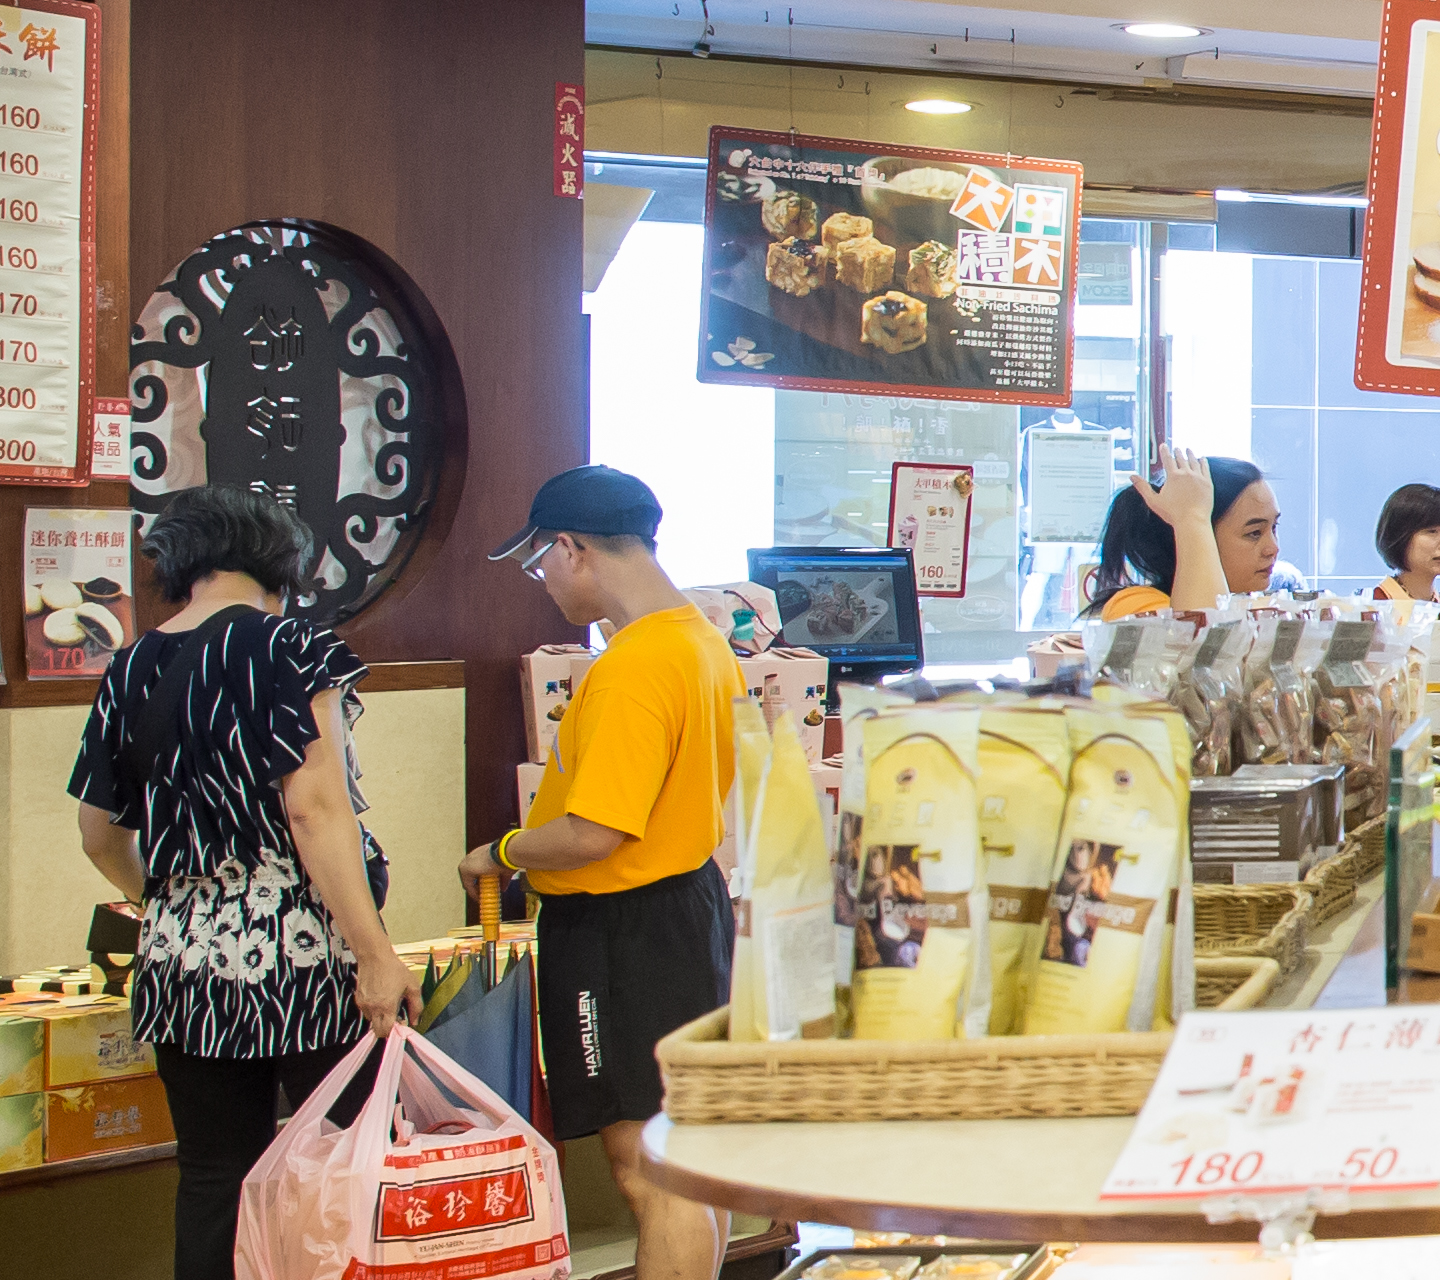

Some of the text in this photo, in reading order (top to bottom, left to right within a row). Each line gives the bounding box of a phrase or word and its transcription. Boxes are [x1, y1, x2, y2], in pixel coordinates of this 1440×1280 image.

[0, 104, 41, 130] 160
[0, 150, 40, 176] 160
[0, 198, 39, 223] 160
[0, 245, 38, 270] 160
[0, 292, 37, 316] 170
[956, 298, 1059, 316] Non-Fried Sachima
[94, 421, 121, 437] 人氣
[93, 441, 121, 457] 商品
[30, 530, 125, 548] 迷你養生酥餅
[919, 566, 944, 579] 160
[43, 648, 85, 669] 170
[1169, 1146, 1399, 1186] 180 50
[403, 1181, 516, 1230] 裕珍馨
